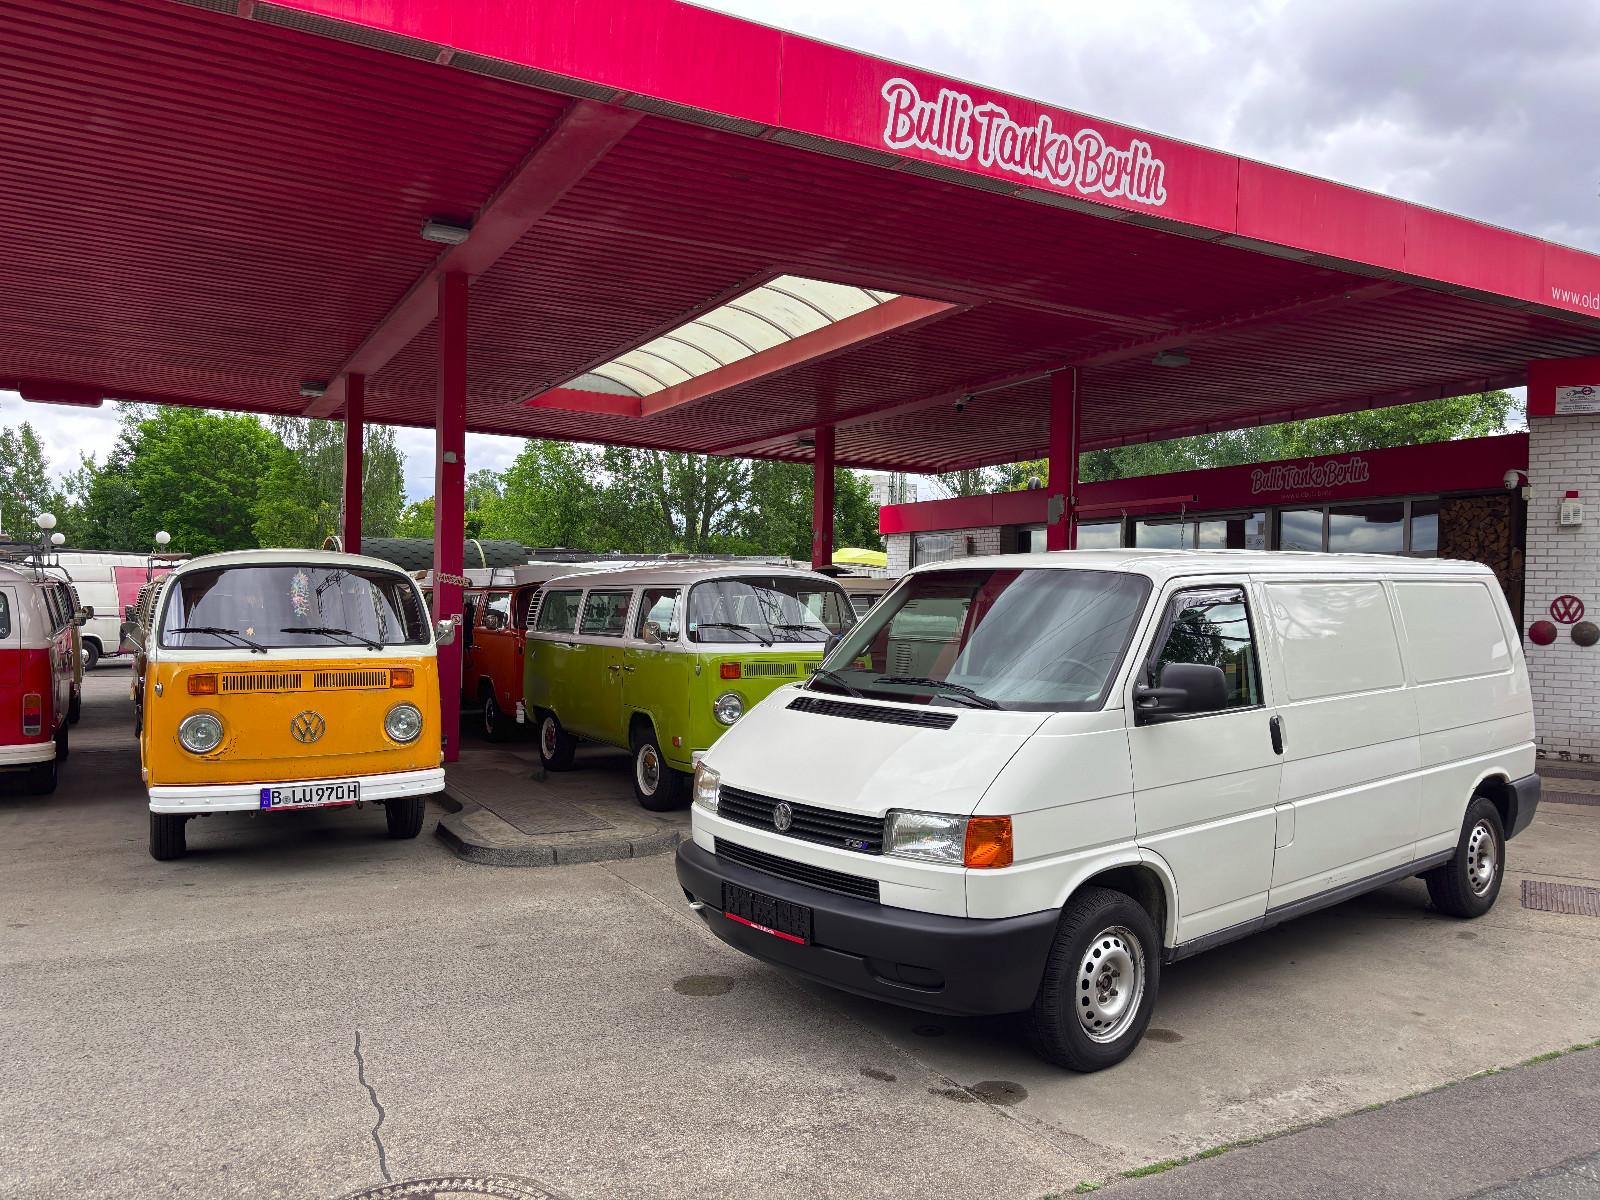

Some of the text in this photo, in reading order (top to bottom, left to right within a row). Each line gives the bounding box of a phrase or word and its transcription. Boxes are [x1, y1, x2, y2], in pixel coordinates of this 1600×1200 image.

[882, 78, 1167, 206] Bulli Tanke Berlin
[1251, 457, 1370, 494] Bulli Tanke Berlin
